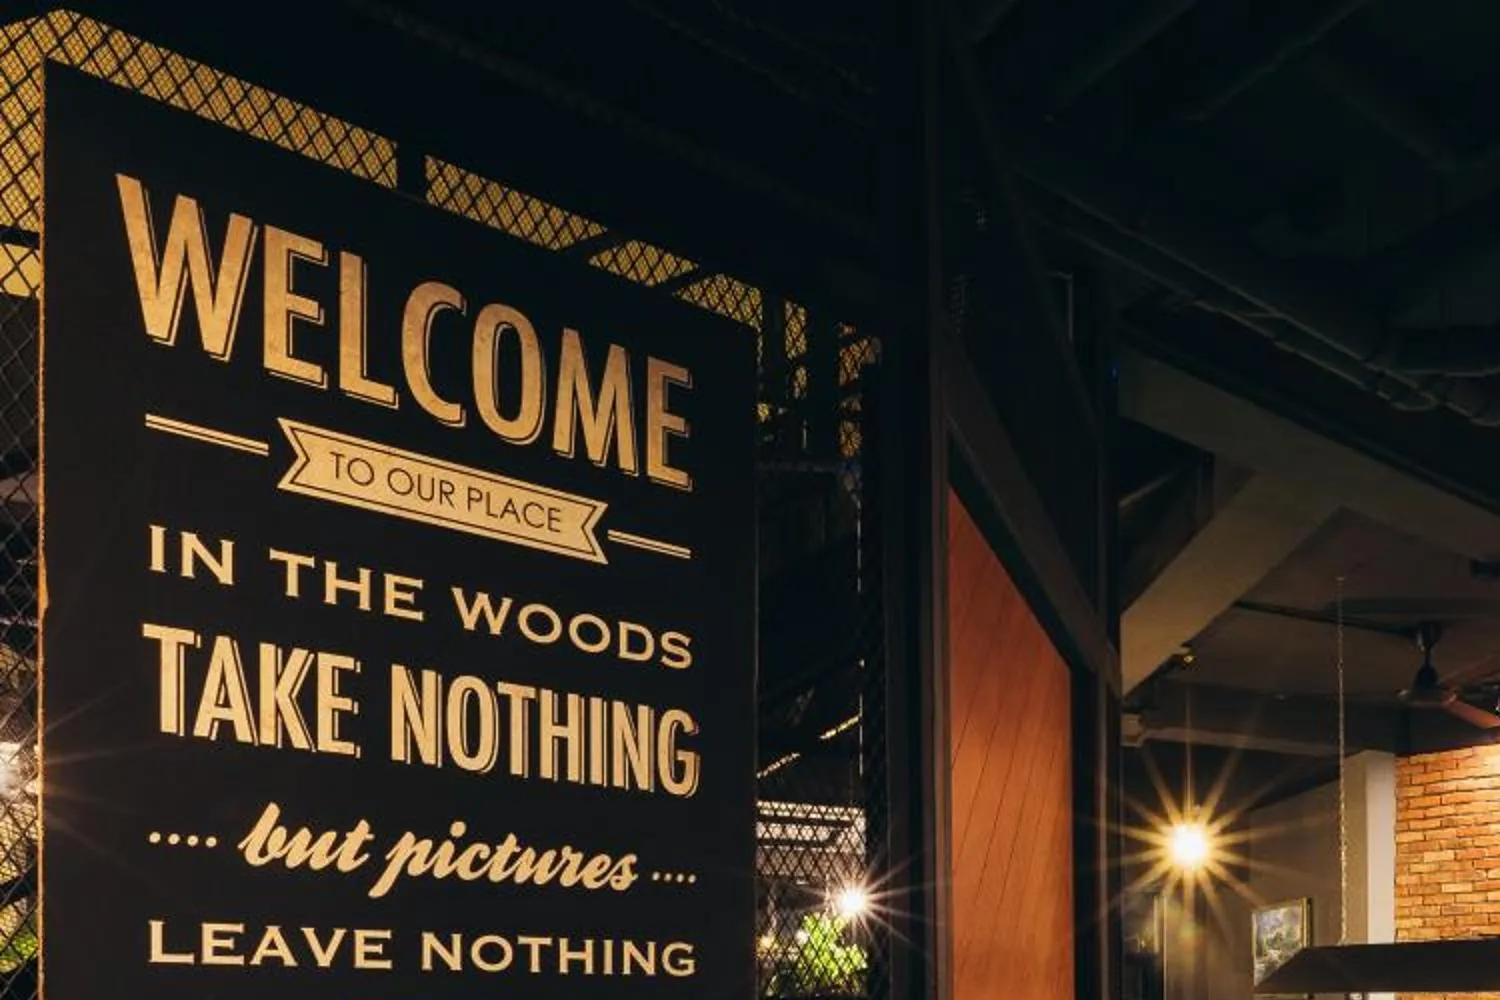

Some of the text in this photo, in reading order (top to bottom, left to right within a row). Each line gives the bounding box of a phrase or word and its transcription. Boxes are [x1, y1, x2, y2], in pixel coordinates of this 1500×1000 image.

[115, 173, 693, 491] WELCOME
[329, 451, 563, 534] TO OUR PLACE
[149, 524, 693, 669] IN THE WOODS
[142, 623, 701, 799] TAKE NOTHING
[237, 801, 639, 899] but pictures
[148, 919, 695, 977] LEAVE NOTHING
